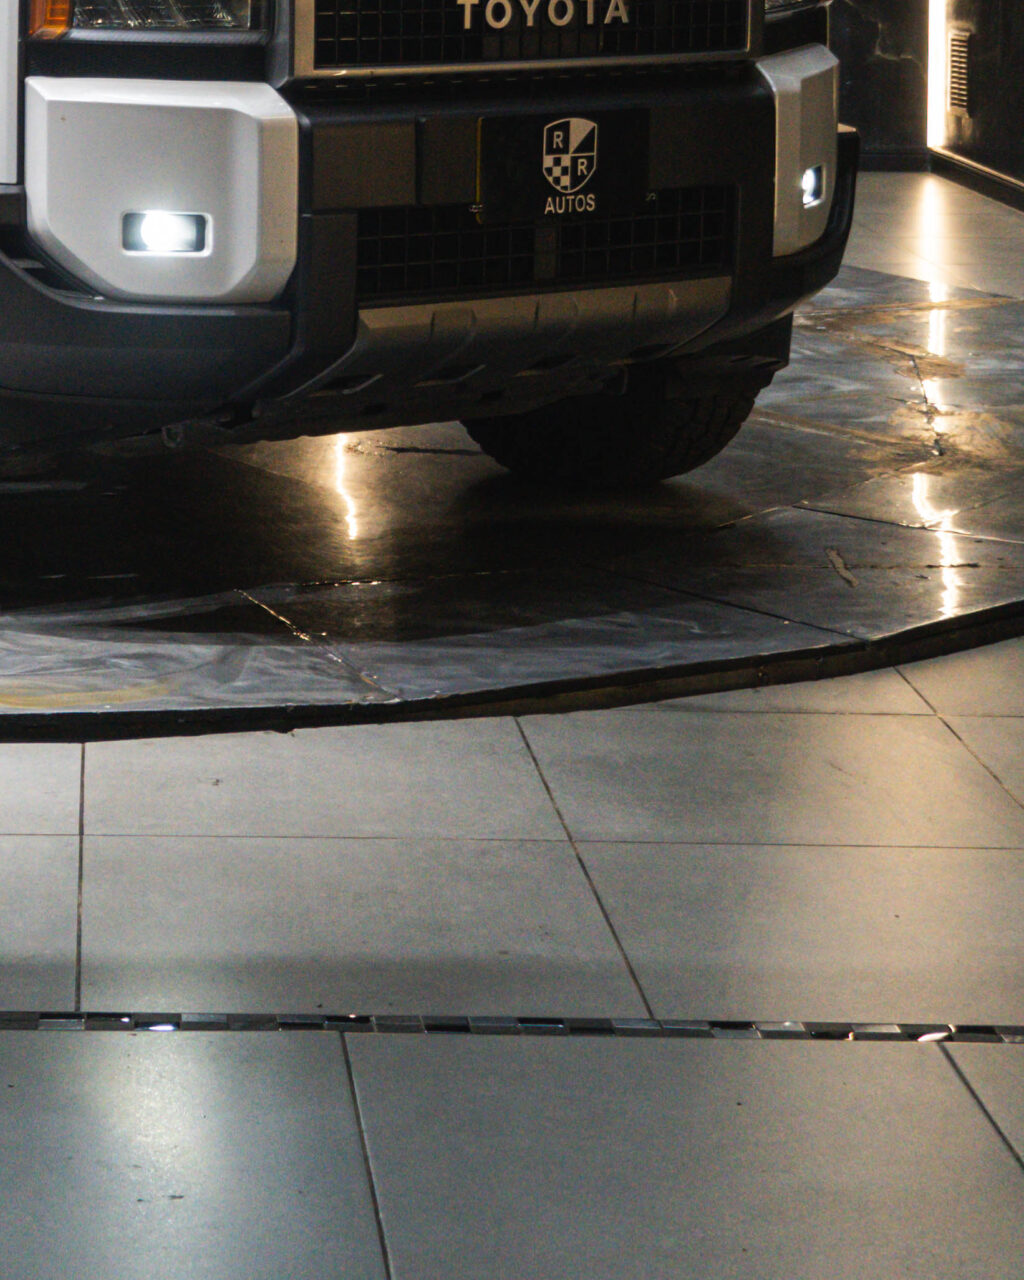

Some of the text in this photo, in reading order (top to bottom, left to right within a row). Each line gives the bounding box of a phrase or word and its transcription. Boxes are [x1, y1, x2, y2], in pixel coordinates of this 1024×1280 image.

[552, 131, 564, 149] R
[577, 158, 588, 176] R
[544, 194, 596, 214] AUTOS
